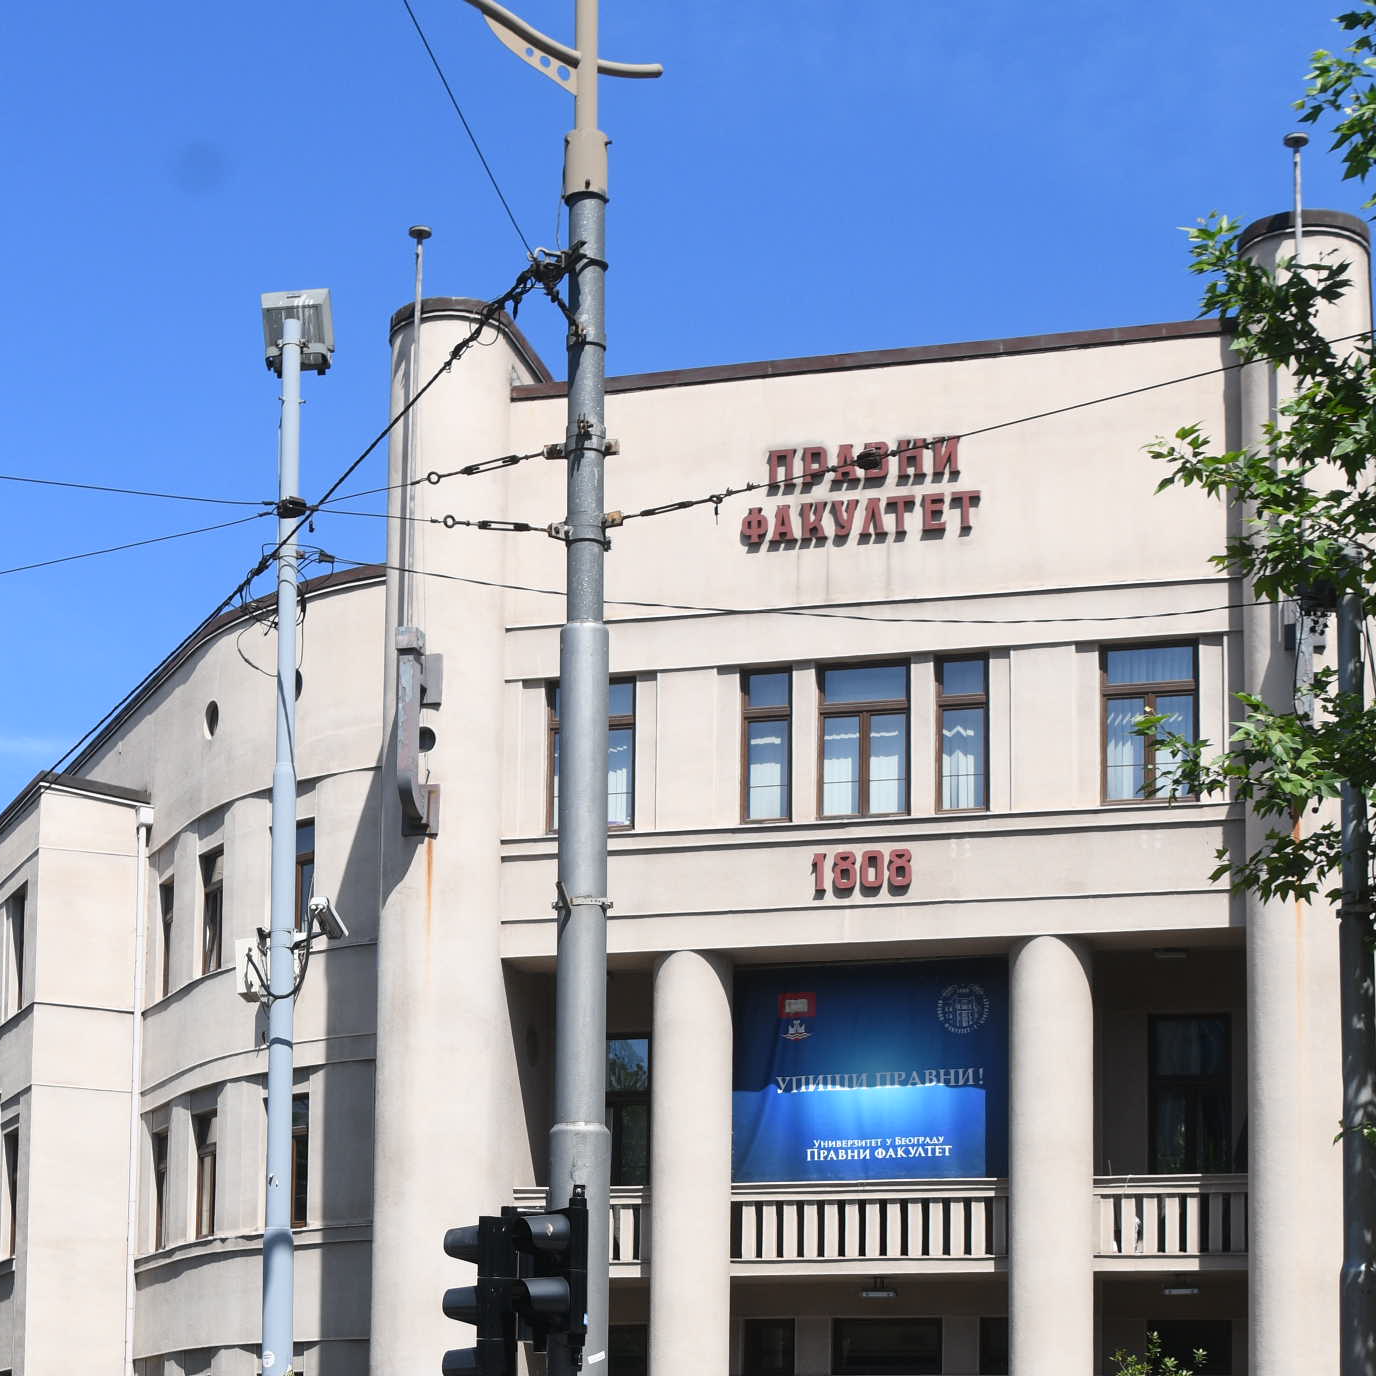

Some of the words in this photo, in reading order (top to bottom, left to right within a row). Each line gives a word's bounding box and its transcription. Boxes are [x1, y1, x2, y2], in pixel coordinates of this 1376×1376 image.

[767, 436, 961, 488] ПРАВНИ
[740, 490, 981, 545] ФАКУЛТЕТ
[811, 848, 913, 892] 1808
[776, 1072, 867, 1094] УПИШИ
[875, 1068, 984, 1089] ПРАВНИ!
